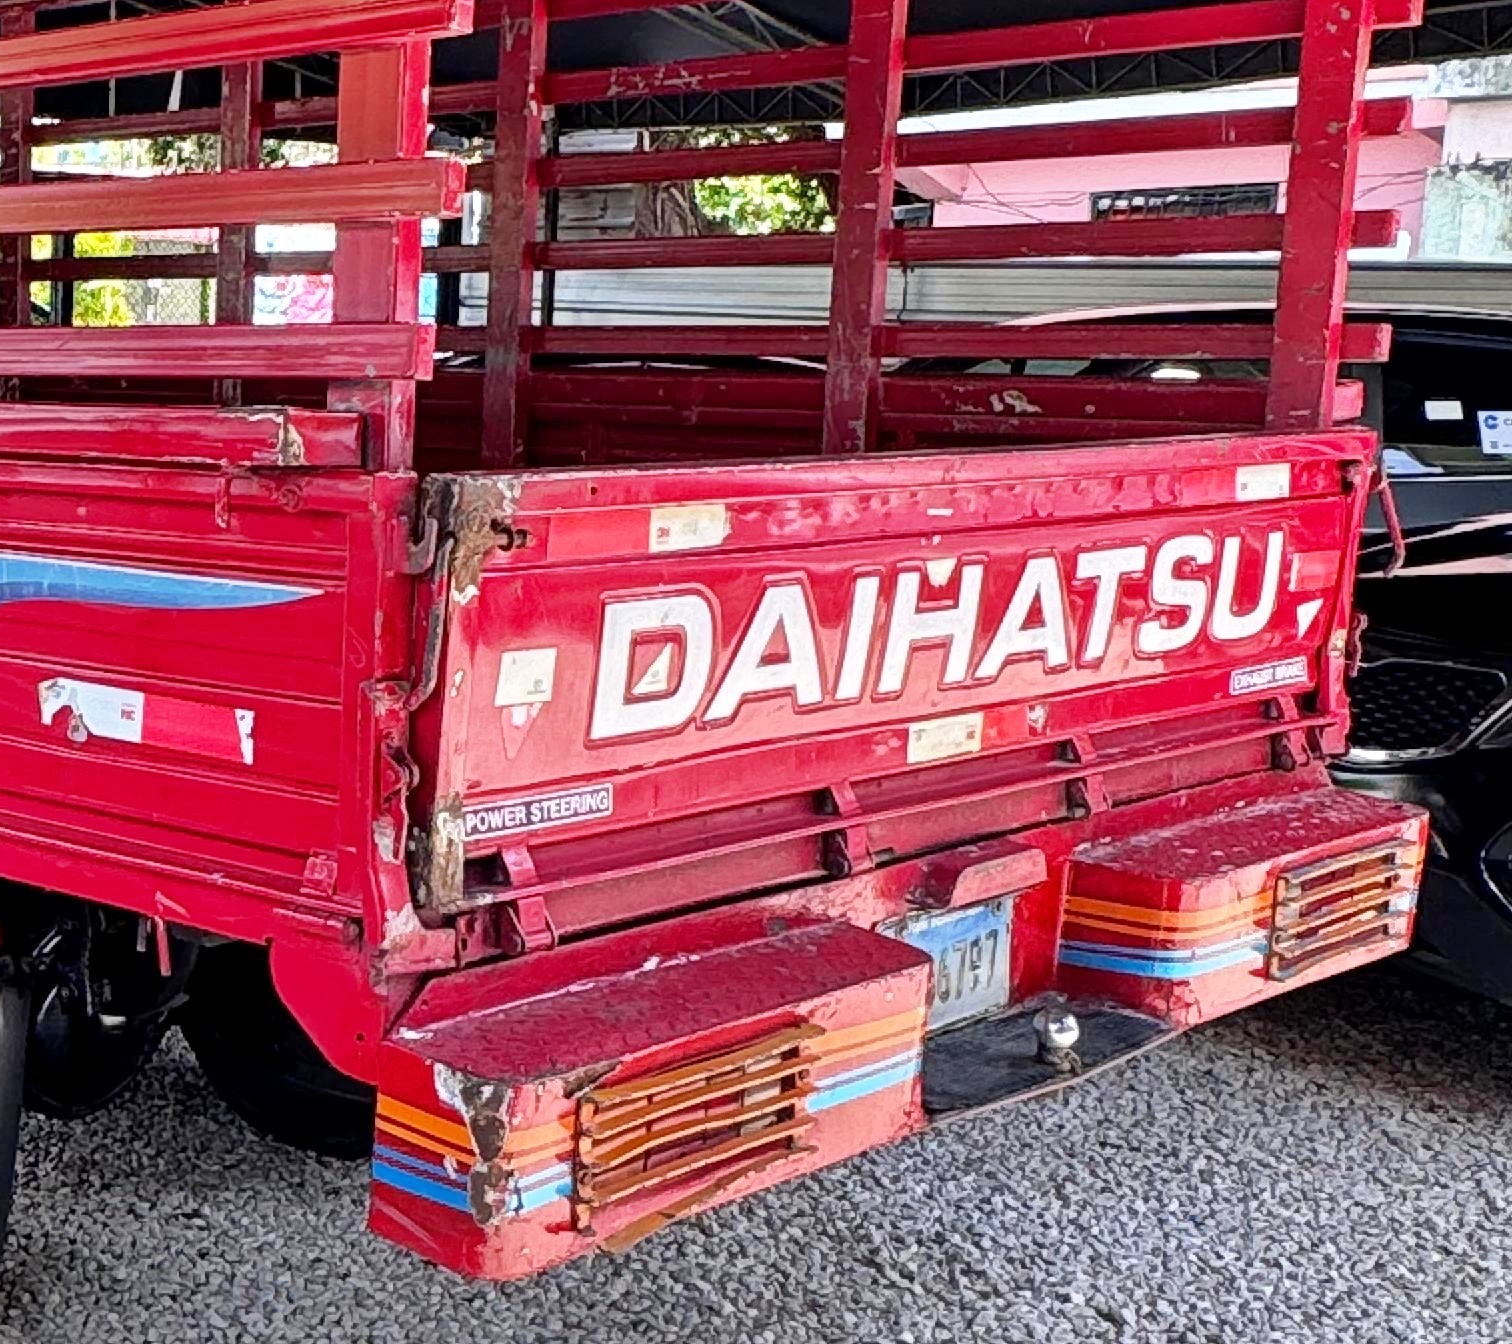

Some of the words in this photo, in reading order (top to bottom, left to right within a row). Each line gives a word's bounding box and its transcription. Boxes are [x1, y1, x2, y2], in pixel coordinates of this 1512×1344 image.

[588, 529, 1285, 742] DAIHATSU
[465, 805, 528, 834] POWER
[530, 790, 609, 823] STEERING
